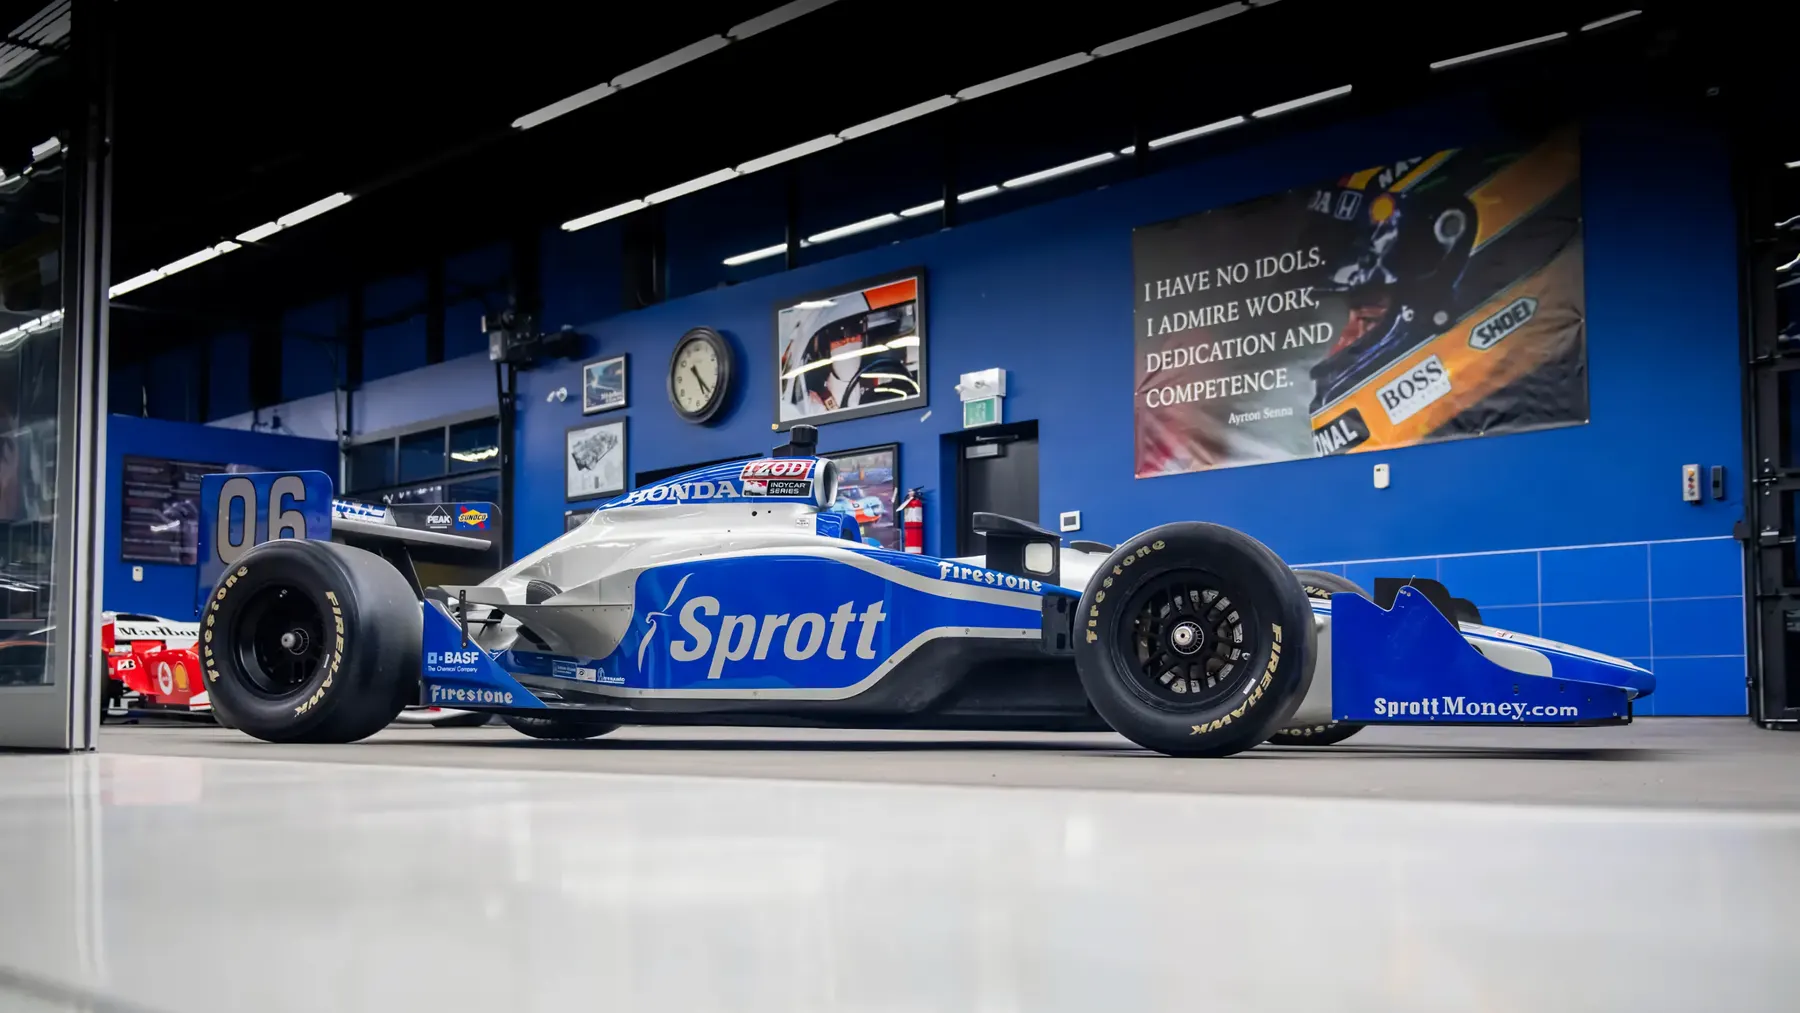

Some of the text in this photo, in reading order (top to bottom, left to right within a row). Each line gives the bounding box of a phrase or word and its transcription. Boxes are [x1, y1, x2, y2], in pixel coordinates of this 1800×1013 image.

[1144, 247, 1326, 302] I HAVE NO IDOLS.
[1147, 286, 1320, 337] I ADMIRE WORK,
[1477, 300, 1532, 345] SHOEI
[1146, 322, 1334, 373] DEDICATION AND
[1146, 367, 1294, 408] COMPETENCE.
[1381, 361, 1442, 411] BOSS
[1228, 406, 1293, 426] Ayrton Senna
[743, 461, 807, 477] IZOD
[622, 481, 741, 504] HONDA
[217, 475, 306, 566] 06
[427, 515, 451, 524] PEAK
[458, 513, 489, 522] SUNOCO
[938, 561, 1042, 592] Firestone
[1086, 540, 1166, 644] Firestone
[204, 566, 249, 682] Firestone
[669, 595, 887, 679] Sprott
[294, 591, 344, 717] FIREHAWK
[444, 652, 479, 664] BASF
[457, 665, 478, 673] Company
[430, 684, 513, 704] Firestone
[1189, 622, 1282, 736] FIREHAWK
